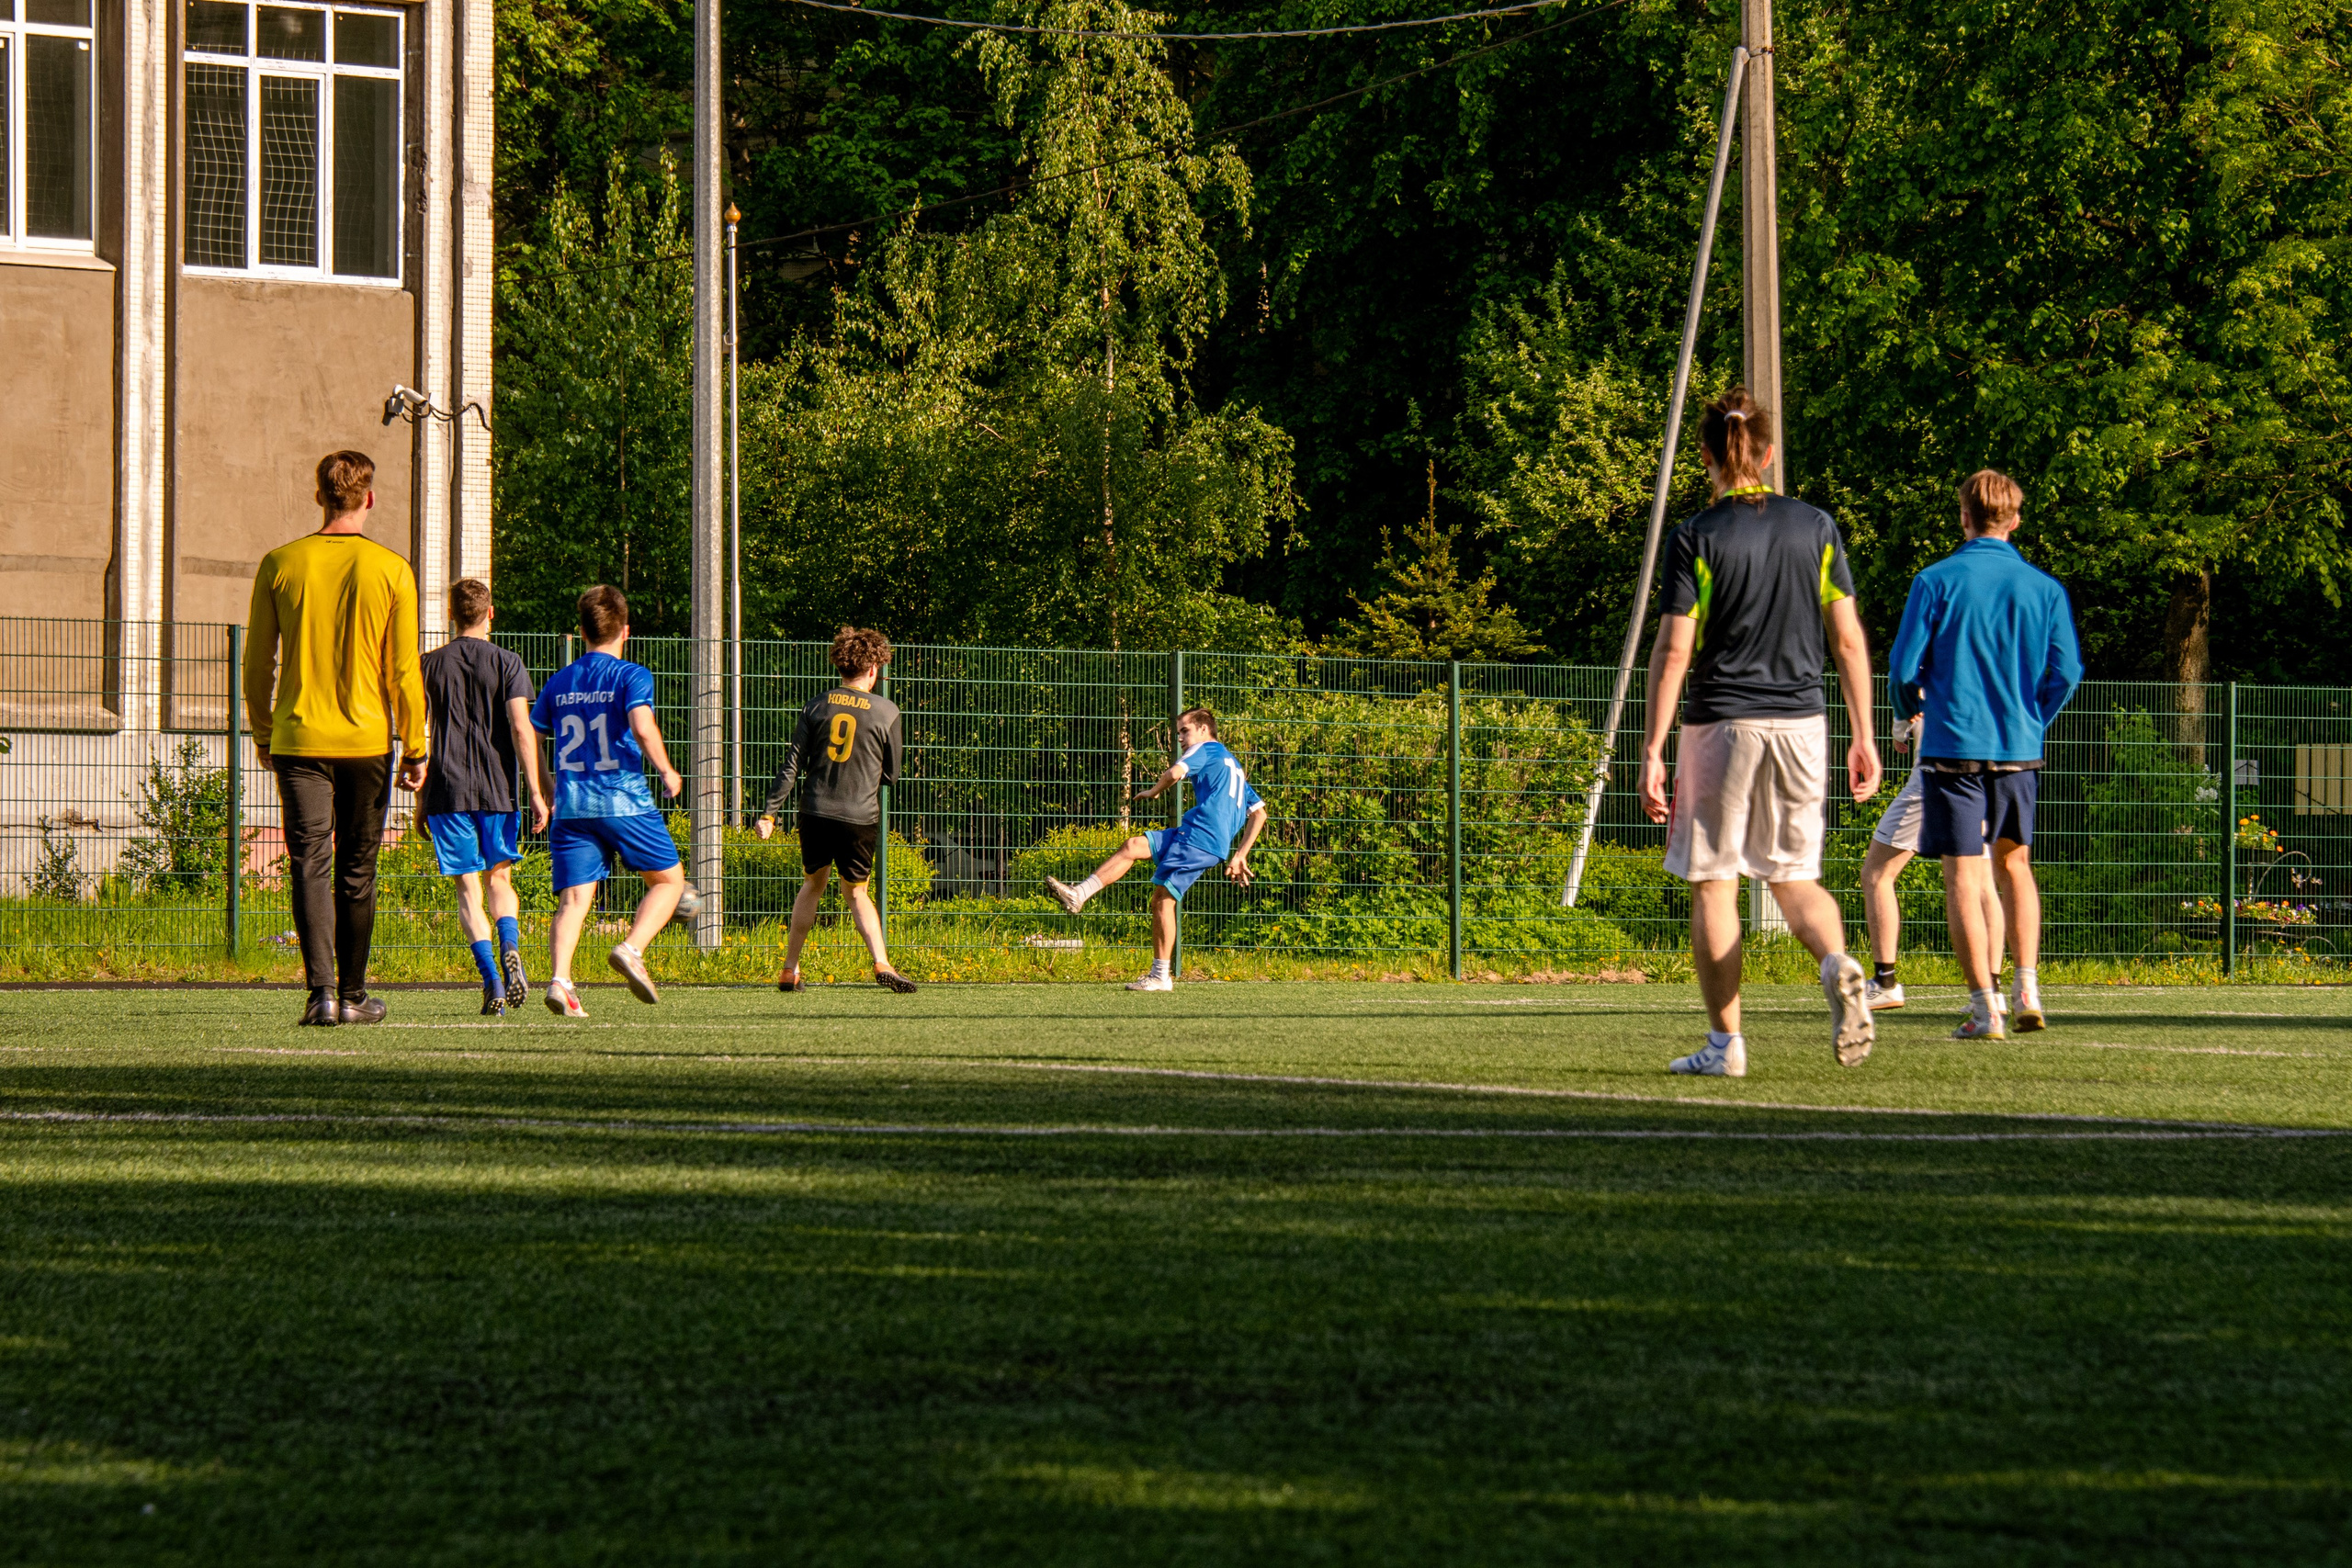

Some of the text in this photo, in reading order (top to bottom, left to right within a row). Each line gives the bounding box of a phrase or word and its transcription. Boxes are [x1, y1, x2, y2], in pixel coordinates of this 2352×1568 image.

[828, 694, 871, 710] КОВАЛЬ
[559, 713, 619, 772] 21
[827, 713, 856, 762] 9
[1224, 758, 1245, 808] 11
